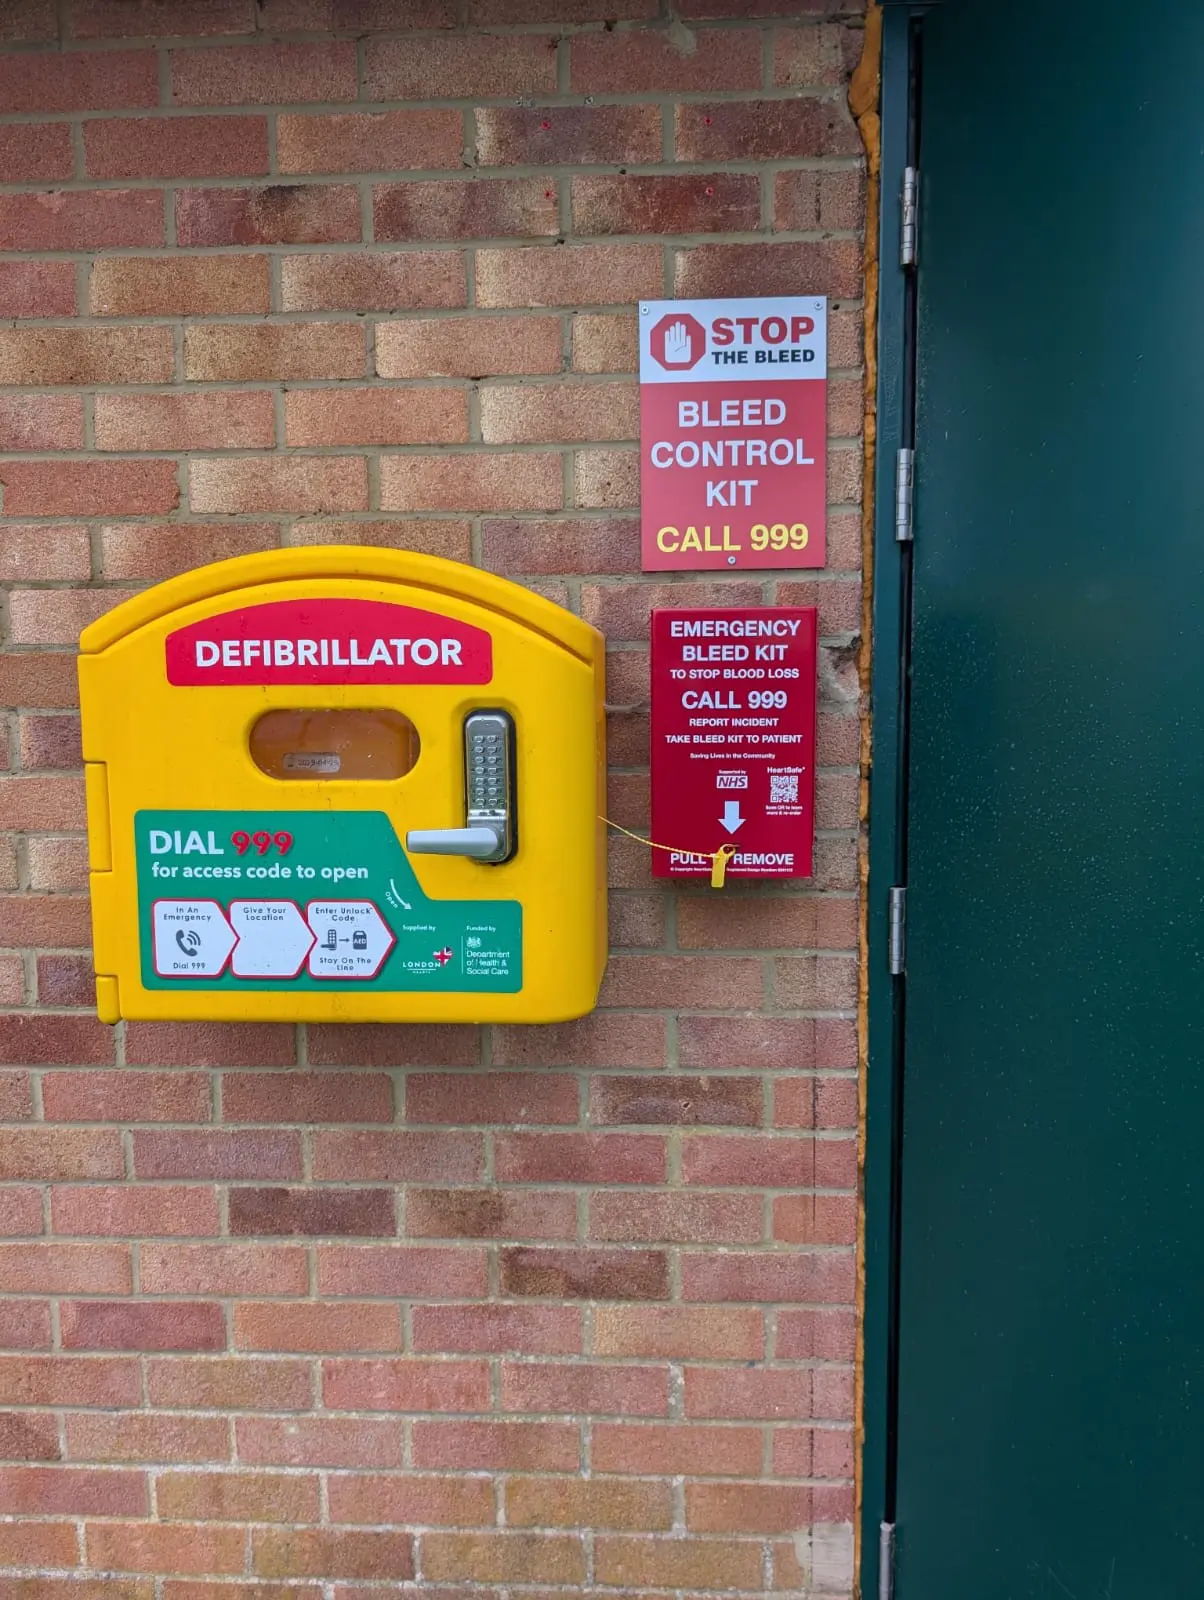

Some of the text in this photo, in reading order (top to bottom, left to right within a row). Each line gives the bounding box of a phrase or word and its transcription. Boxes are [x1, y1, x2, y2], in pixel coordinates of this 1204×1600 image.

[711, 316, 815, 346] STOP
[711, 349, 816, 365] THE BLEED
[678, 399, 787, 428] BLEED
[650, 438, 815, 468] CONTROL
[706, 479, 759, 508] KIT
[656, 523, 809, 553] CALL 999
[670, 619, 801, 637] EMERGENCY
[194, 638, 464, 668] DEFIBRILLATOR
[682, 644, 789, 662] BLEED KIT
[670, 668, 800, 679] TO STOP BLOOD LOSS
[681, 690, 787, 710] CALL 999
[689, 718, 779, 727] REPORT INCIDENT
[665, 735, 802, 743] TAKE BLEED KIT TO PATIENT
[743, 752, 776, 760] Community
[718, 776, 746, 787] NHS
[149, 830, 294, 856] DIAL 999
[670, 853, 707, 864] PULL
[733, 854, 794, 865] REMOVE
[152, 862, 368, 882] for access code to open
[163, 914, 212, 922] Emergency
[319, 957, 338, 965] Stay
[466, 967, 490, 975] Social
